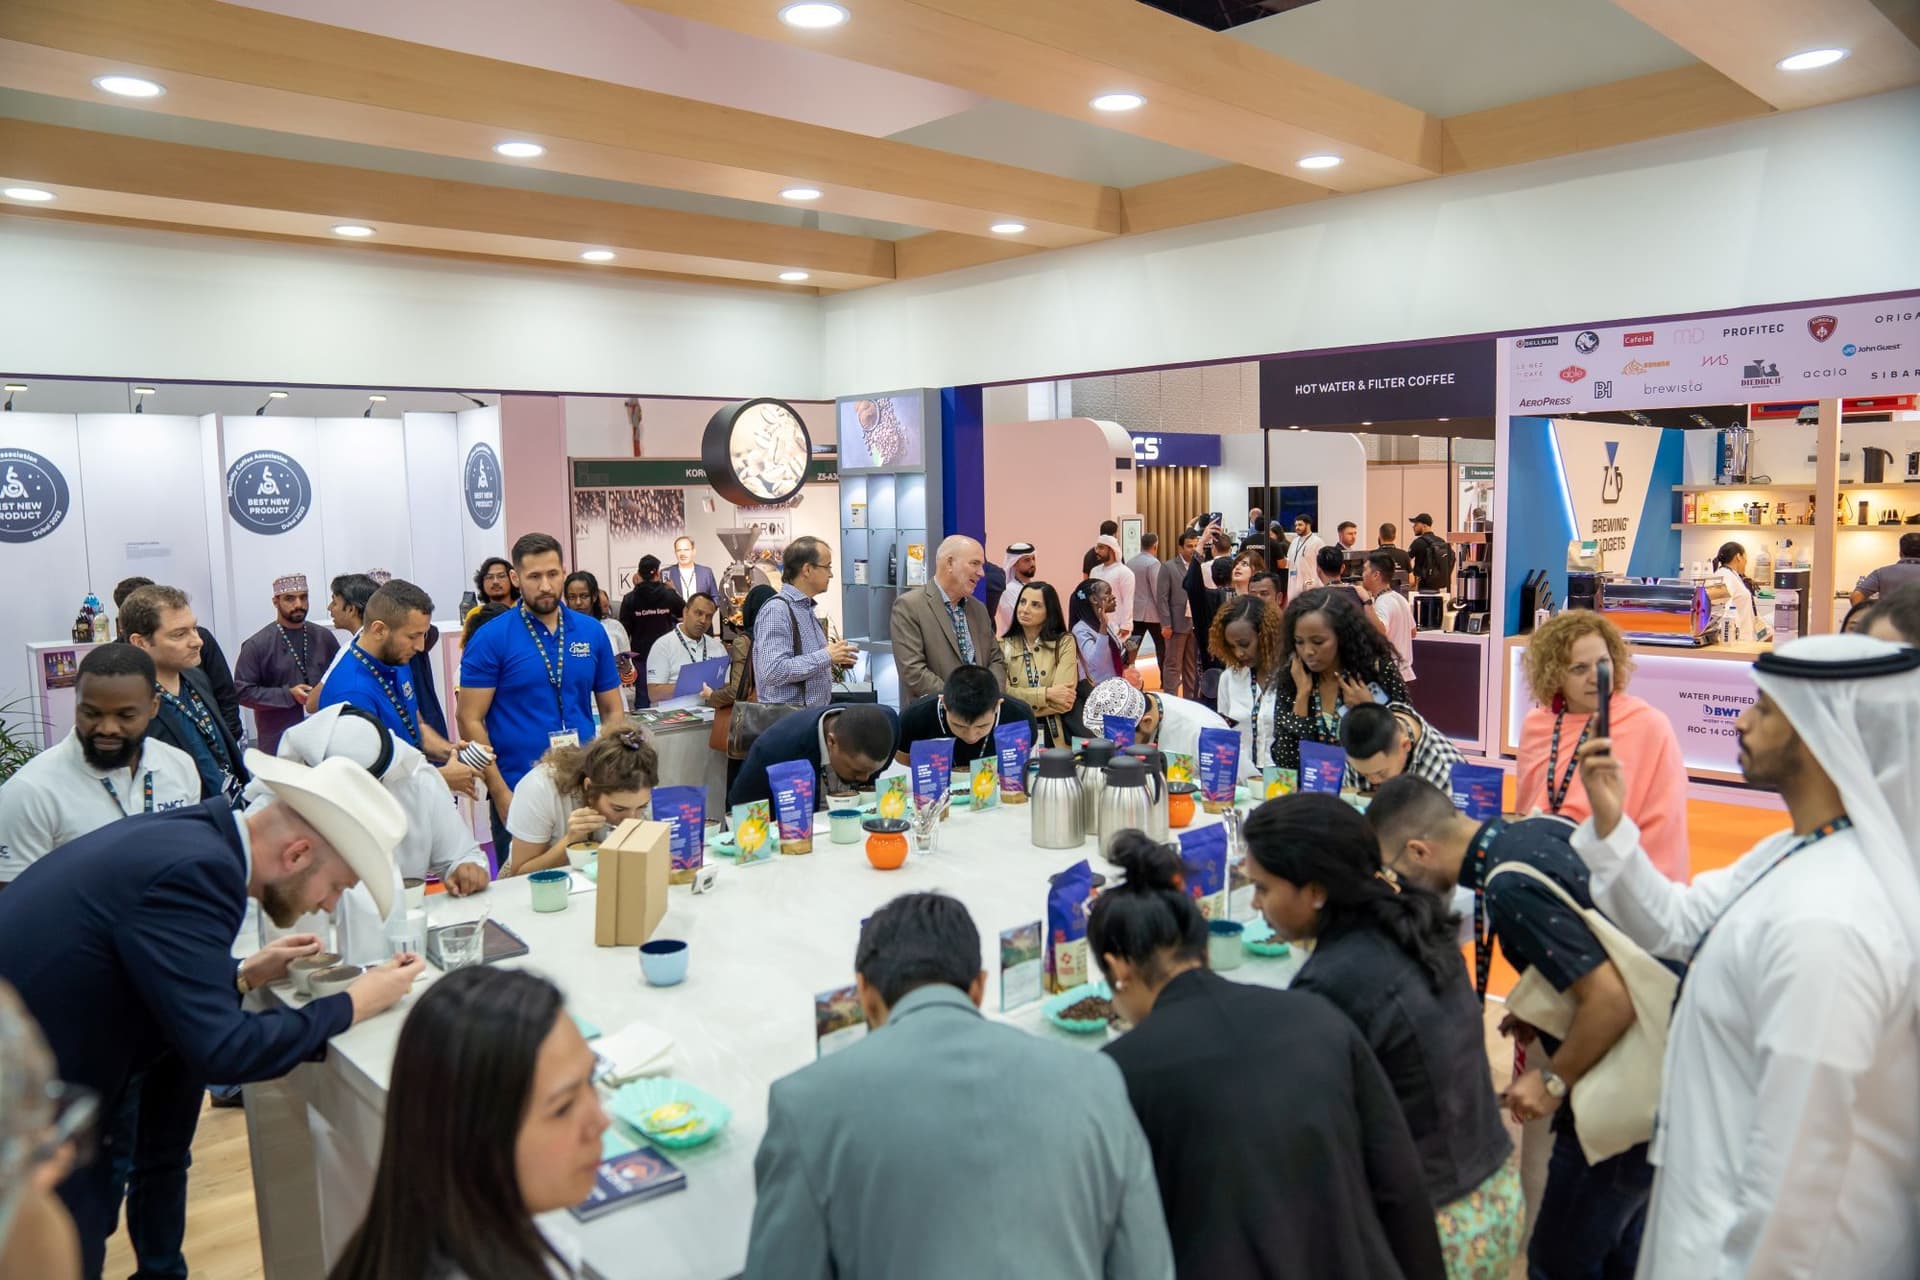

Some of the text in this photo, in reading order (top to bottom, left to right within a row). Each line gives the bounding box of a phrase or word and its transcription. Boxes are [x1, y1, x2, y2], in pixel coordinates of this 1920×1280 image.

[1723, 324, 1784, 337] PROFITEC
[1296, 373, 1455, 394] HOT WATER & FILTER COFFEE
[1644, 380, 1703, 394] brewista
[1740, 377, 1781, 387] DIEDRICH
[1132, 437, 1159, 460] CS
[0, 451, 37, 463] ssociation
[685, 469, 707, 478] KOR
[17, 502, 42, 510] NEW
[248, 498, 290, 506] BEST NEW
[0, 512, 41, 520] RODUCT
[1592, 518, 1627, 533] BREWING
[1594, 536, 1626, 552] DGETS
[1679, 692, 1754, 704] WATER PURIFIED
[1714, 707, 1741, 717] BWT
[1688, 726, 1707, 734] ROC
